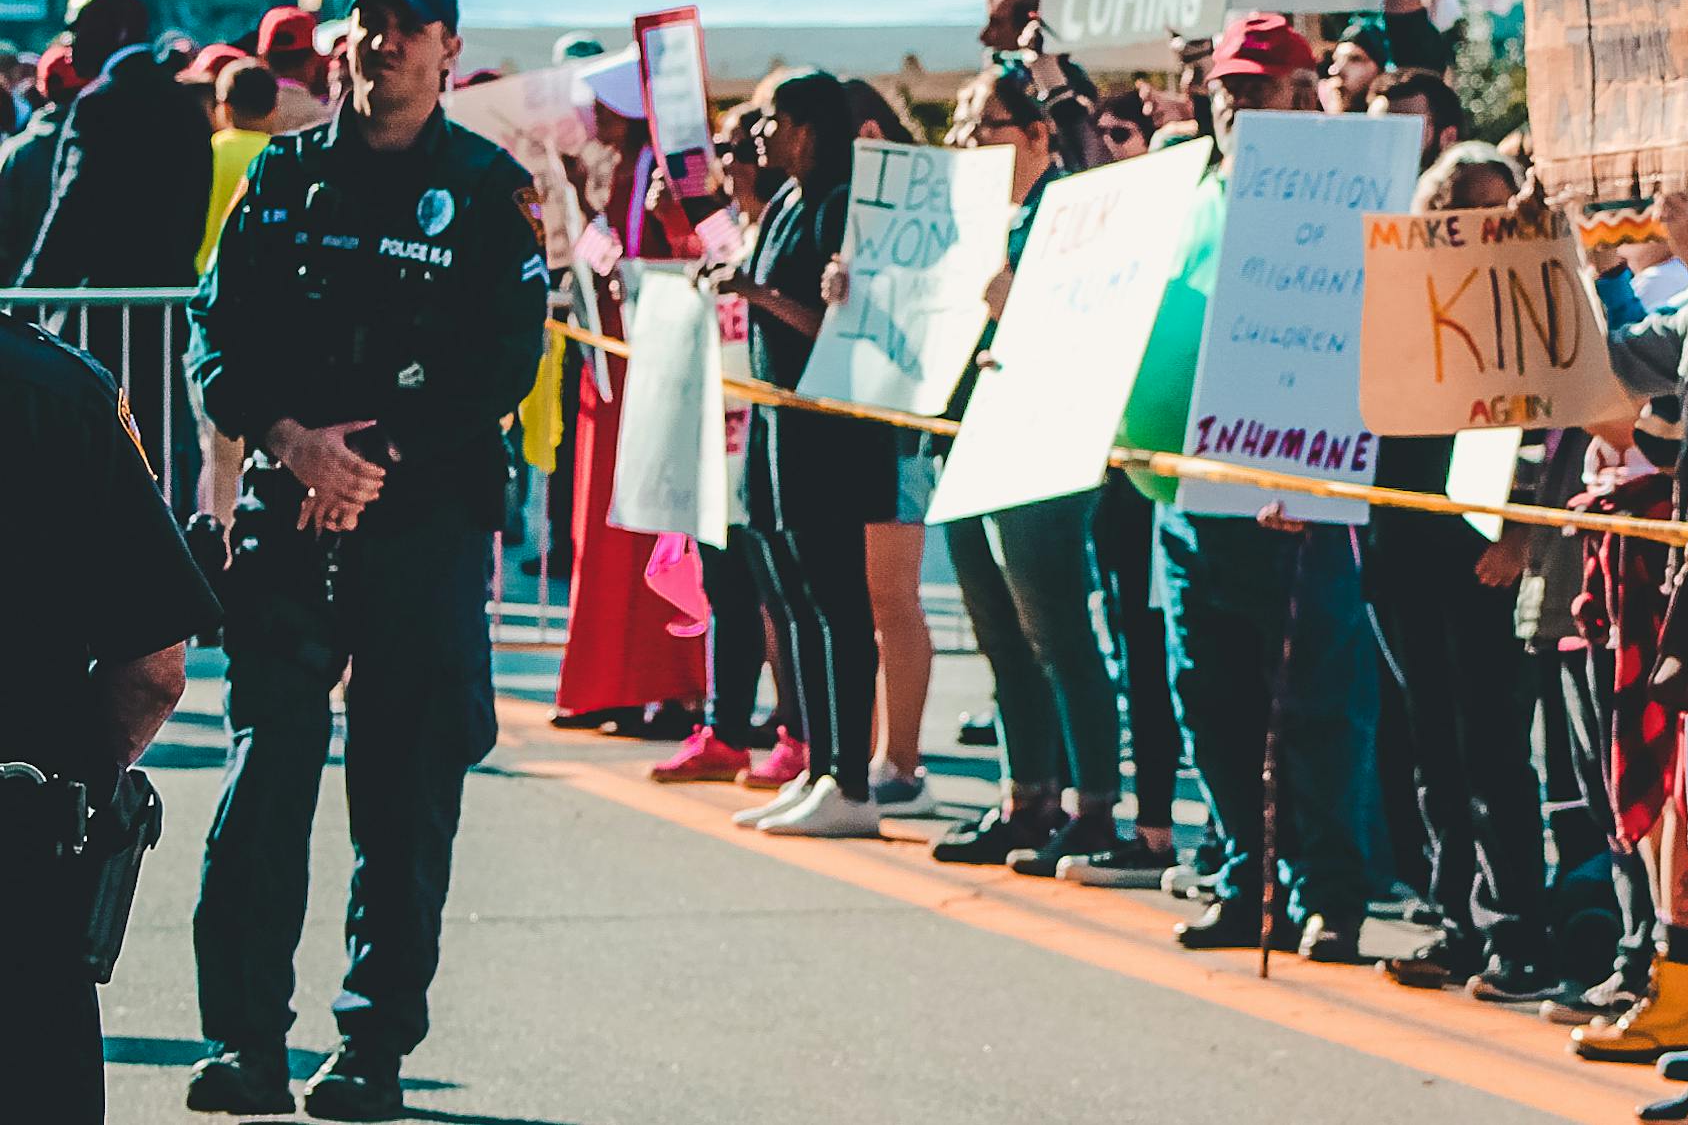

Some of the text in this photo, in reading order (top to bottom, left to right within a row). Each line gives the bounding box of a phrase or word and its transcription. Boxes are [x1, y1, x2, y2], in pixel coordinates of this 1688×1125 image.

[380, 236, 428, 262] POLICE
[1369, 215, 1465, 250] MAKE
[1426, 259, 1581, 384] KIND
[1195, 415, 1373, 472] INHUMANE
